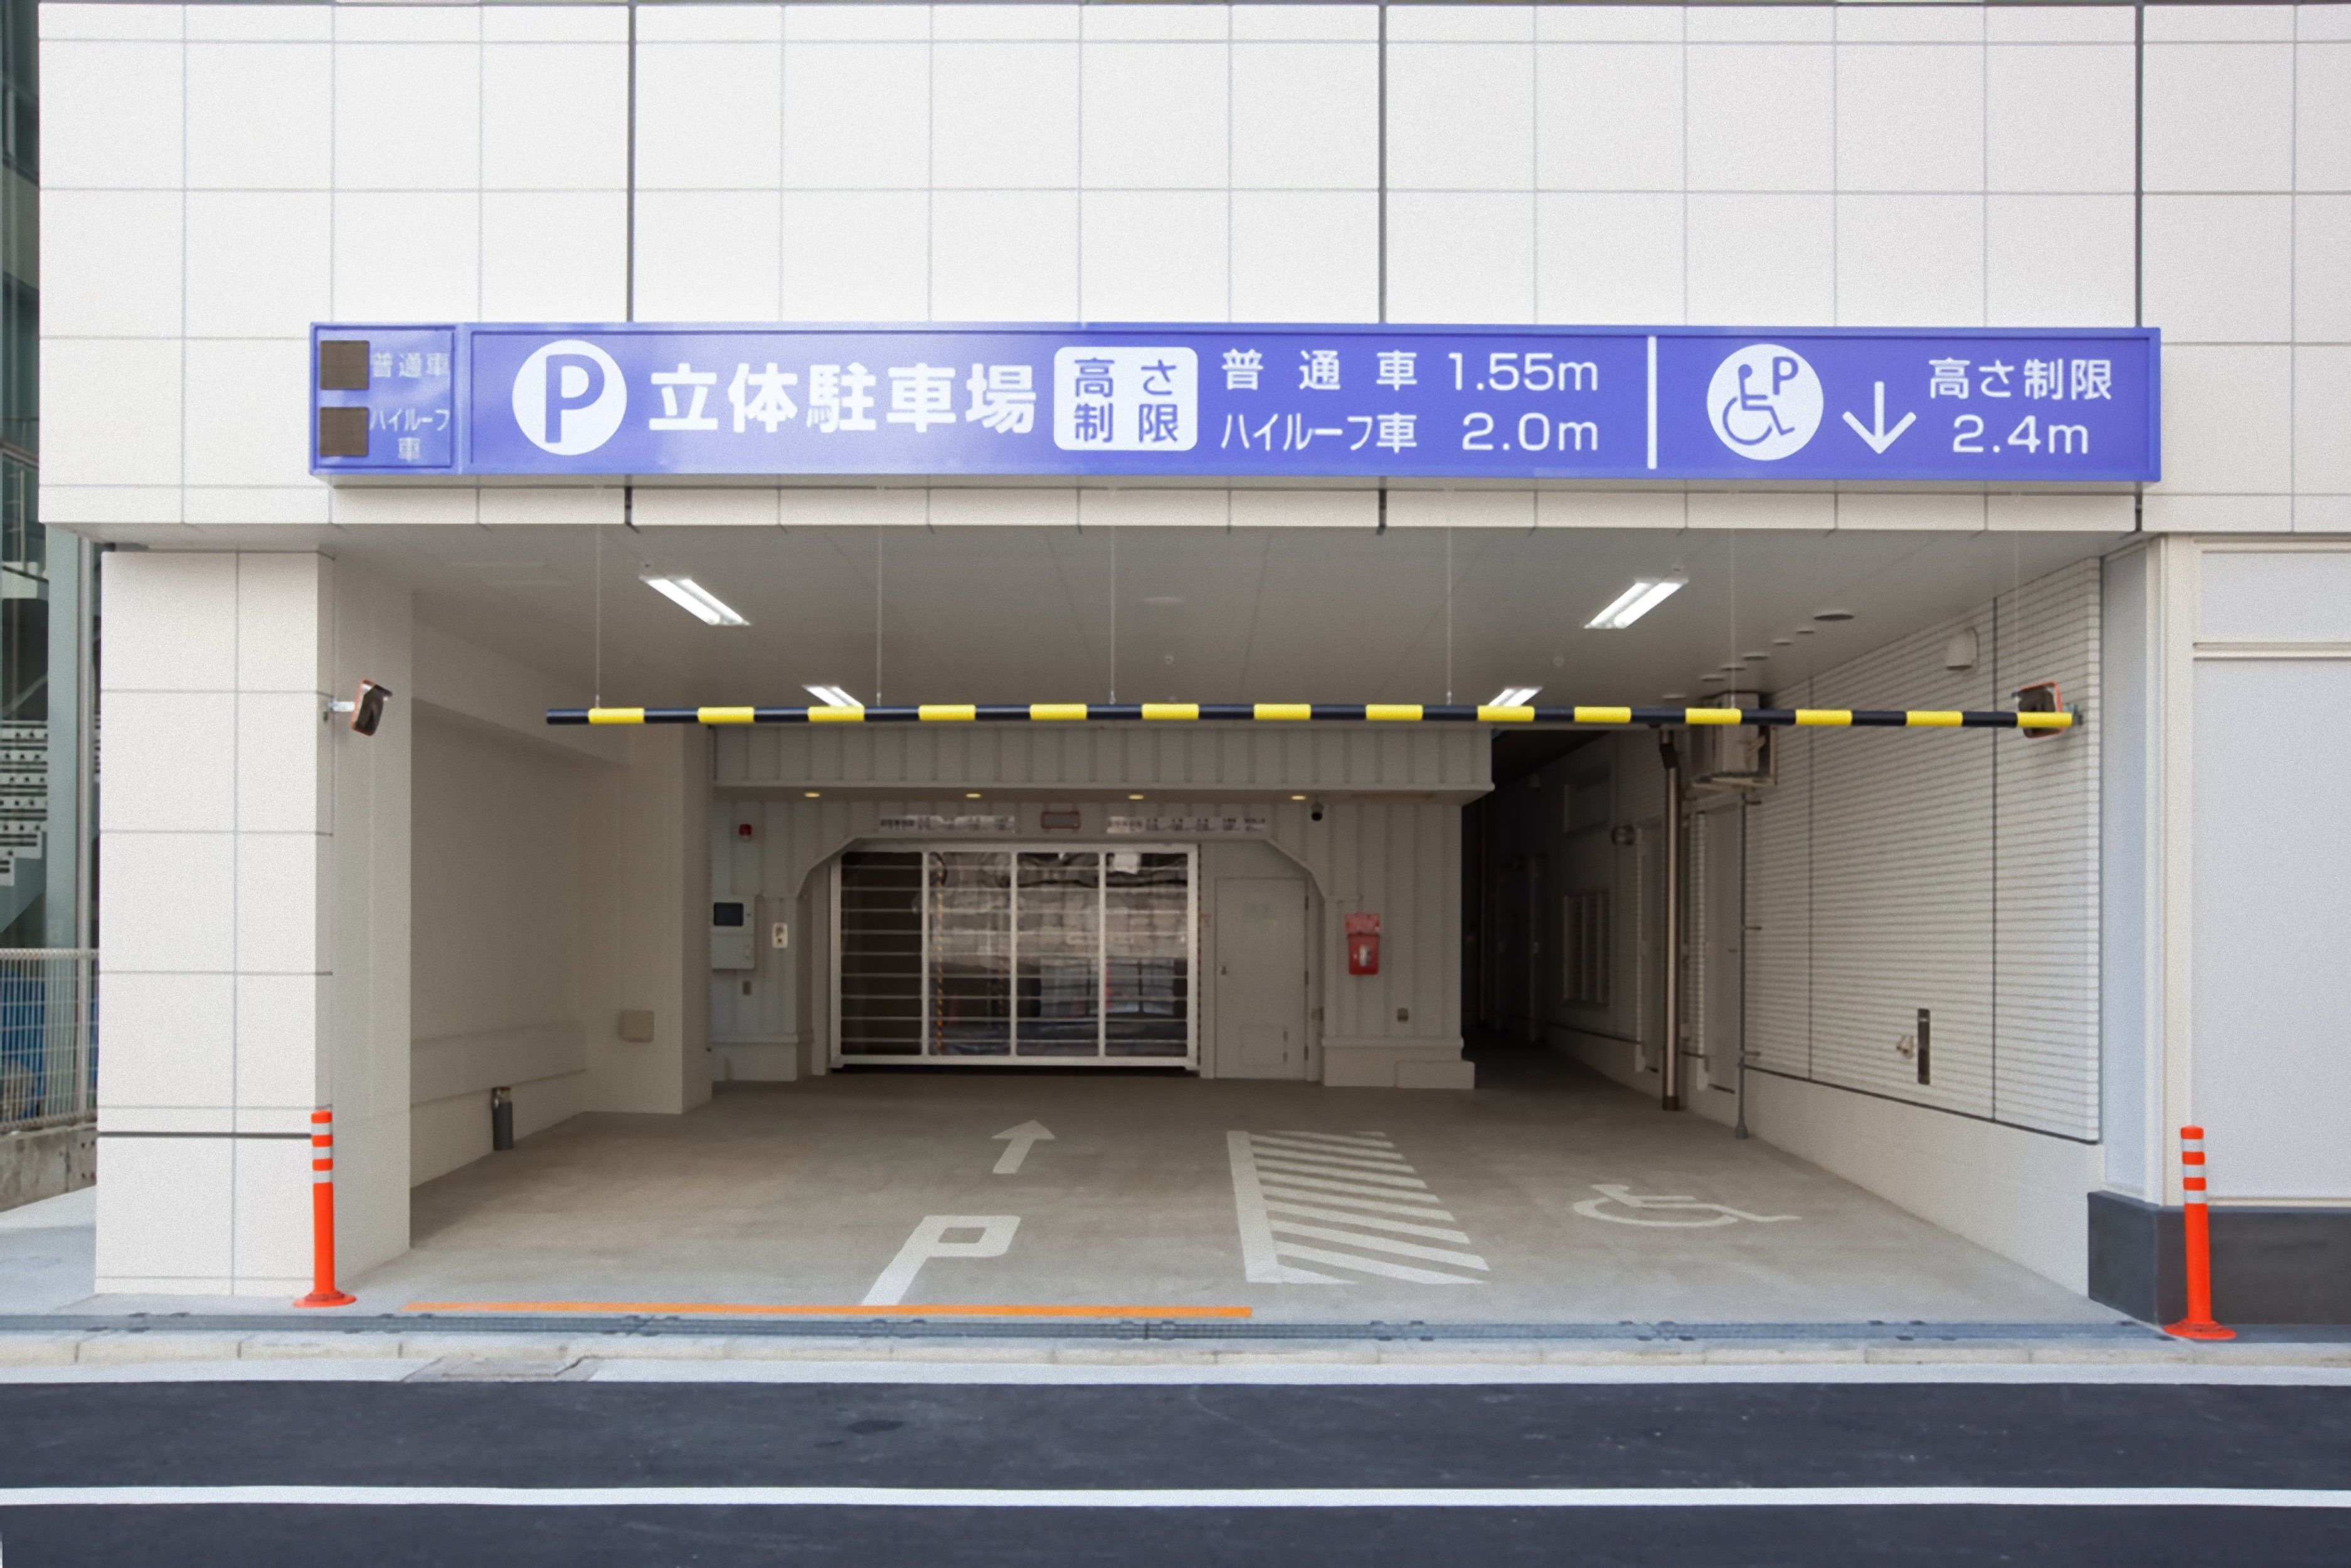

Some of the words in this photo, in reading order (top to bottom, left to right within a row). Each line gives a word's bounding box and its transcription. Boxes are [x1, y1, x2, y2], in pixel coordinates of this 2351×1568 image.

[1074, 357, 1177, 399] 高さ
[1222, 349, 1418, 390] 普通車
[1448, 351, 1598, 391] 1.55m
[1771, 356, 1799, 395] P
[1928, 358, 2112, 400] 高さ制限
[544, 353, 605, 444] P
[649, 362, 1037, 434] 立体駐車場
[1073, 401, 1180, 443] 制限
[1221, 411, 1418, 453] ハイルーフ車
[1462, 412, 1598, 451] 2.0m
[1952, 415, 2089, 454] 2.4m
[861, 1215, 1021, 1306] P
